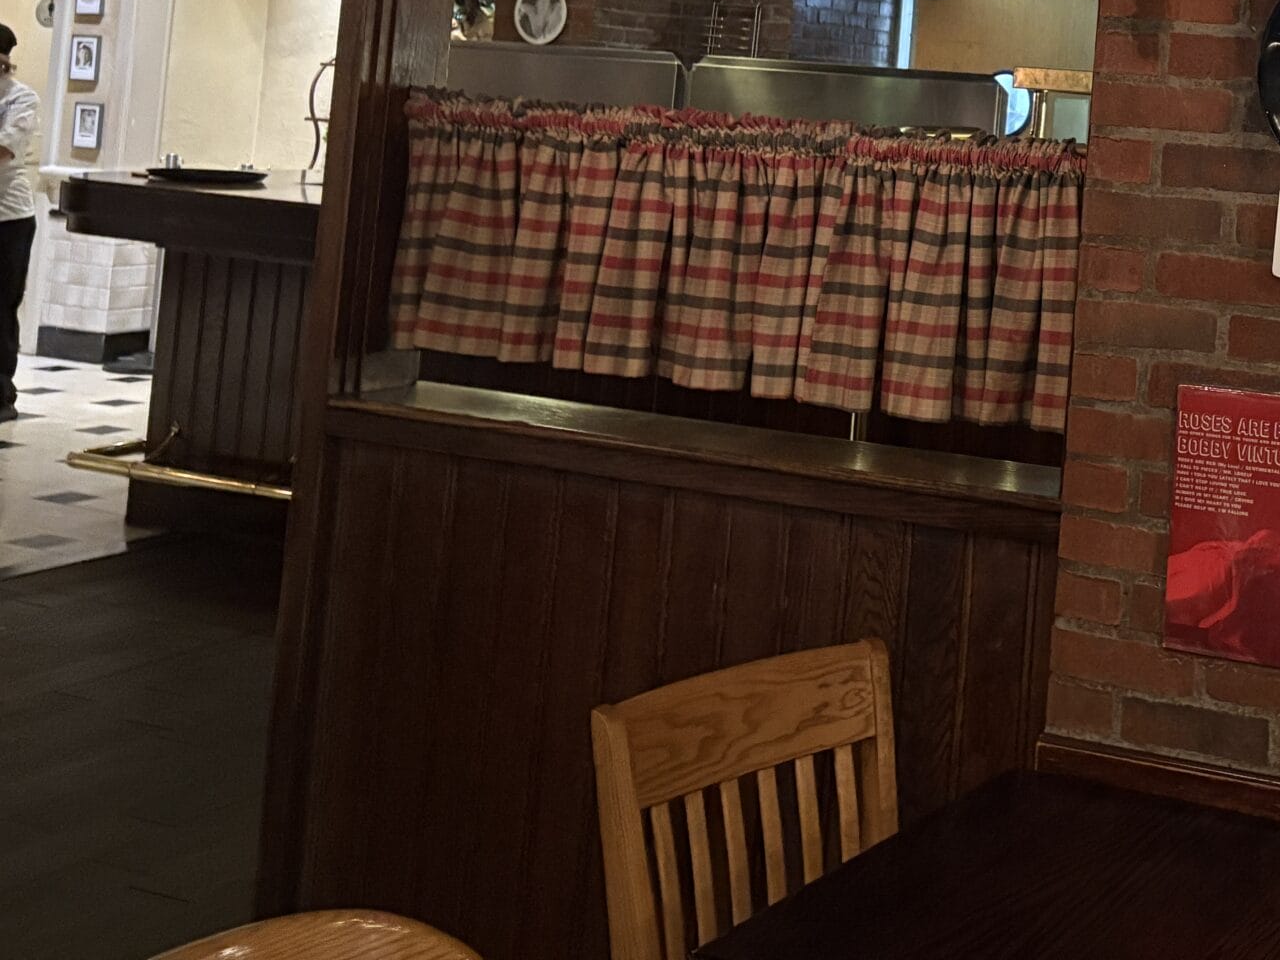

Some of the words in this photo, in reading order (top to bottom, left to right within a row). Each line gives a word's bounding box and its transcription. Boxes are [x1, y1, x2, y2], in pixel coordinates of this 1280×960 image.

[1179, 411, 1232, 433] ROSES
[1237, 418, 1270, 438] ARE
[1178, 436, 1231, 459] BOBBY
